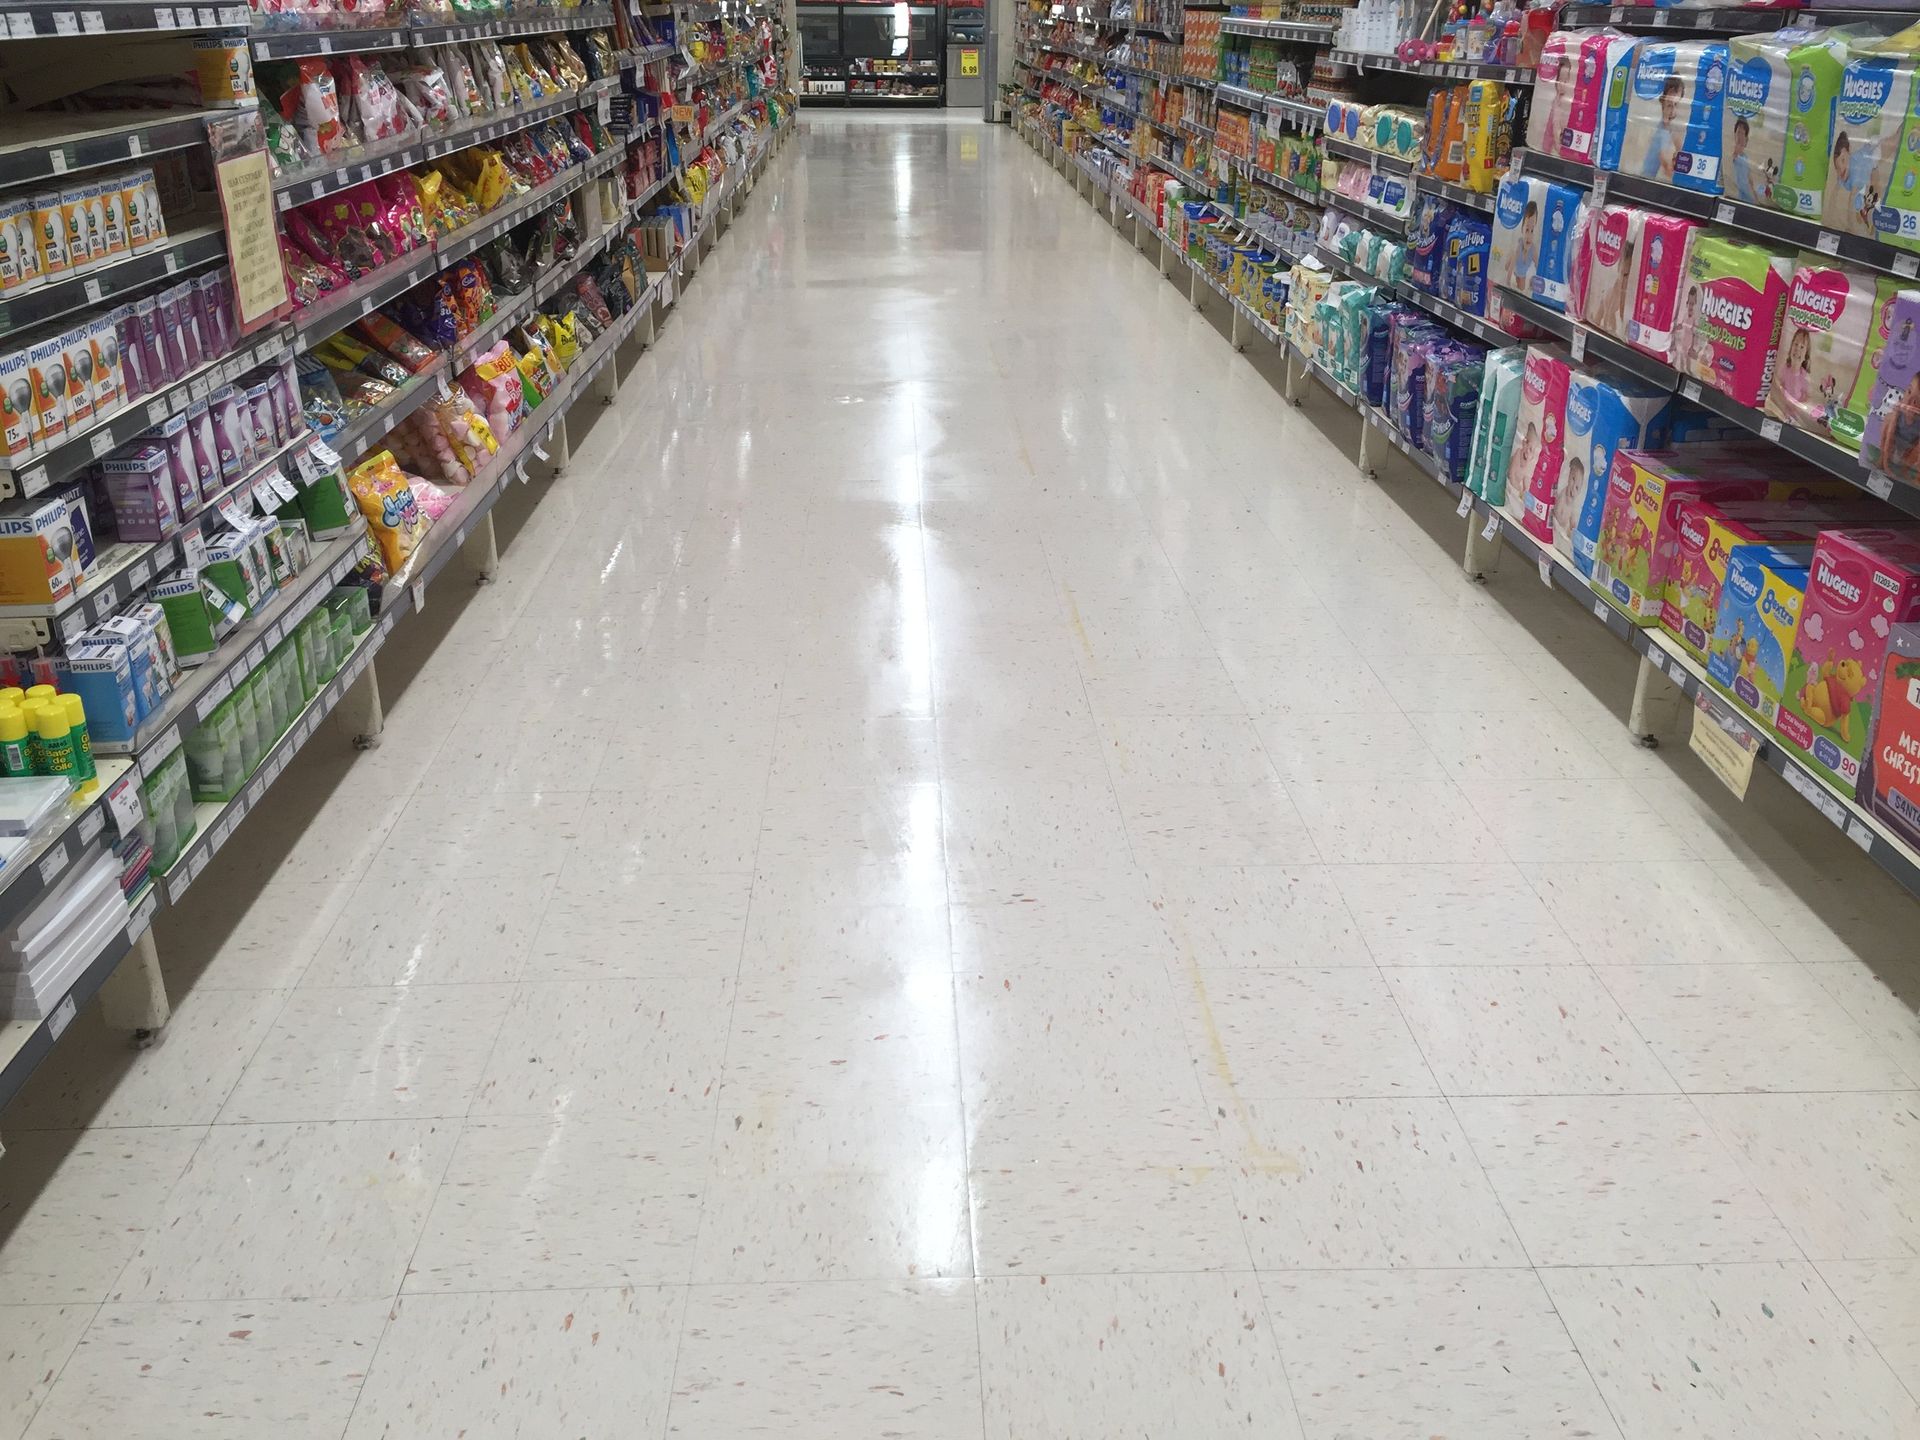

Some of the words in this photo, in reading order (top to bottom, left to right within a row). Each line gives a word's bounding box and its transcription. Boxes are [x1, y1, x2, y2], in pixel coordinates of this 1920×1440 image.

[962, 66, 977, 74] 6.99
[1729, 74, 1764, 99] HUGGIES
[1844, 75, 1884, 99] HUGGIES
[674, 108, 692, 117] NEW
[1696, 159, 1707, 172] 36
[63, 192, 84, 204] PHILIPS
[101, 182, 120, 195] PHILIPS
[37, 196, 60, 209] PHILIPS
[1500, 193, 1523, 214] HUGGIES
[1799, 193, 1813, 207] 28
[1902, 214, 1917, 230] 26
[1458, 231, 1485, 250] Pull-Ups
[1597, 226, 1622, 248] HUGGIES
[1470, 258, 1477, 272] L
[1471, 291, 1479, 304] 15
[1793, 280, 1837, 315] HUGGIES
[1701, 287, 1754, 331] HUGGIES
[89, 314, 114, 336] PHILIPS
[60, 327, 88, 349] PHILIPS
[30, 340, 61, 363] PHILIPS
[1524, 368, 1546, 394] HUGGIES
[1756, 349, 1778, 401] HUGGIES
[210, 386, 233, 403] PHILIPS
[246, 384, 267, 398] PHILIPS
[188, 398, 207, 416] PHILIPS
[1568, 396, 1592, 423] HUGGIES
[167, 413, 187, 433] PHILIPS
[105, 463, 146, 473] PHILIPS
[148, 451, 167, 469] PHILIPS
[1611, 473, 1632, 493] HUGGIES
[1634, 484, 1644, 505] 6
[1642, 493, 1659, 512] extra
[35, 502, 67, 532] PHILIPS
[262, 520, 280, 535] PHILIPS
[1680, 521, 1705, 548] HUGGIES
[1708, 537, 1721, 562] 8
[150, 582, 195, 599] PHILIPS
[1730, 567, 1758, 598] HUGGIES
[1817, 563, 1861, 604] HUGGIES
[1874, 573, 1899, 593] 11203-20
[1762, 588, 1775, 615] 8
[1771, 600, 1795, 627] extra
[82, 637, 124, 648] PHILIPS
[72, 662, 113, 672] PHILIPS
[50, 761, 73, 772] colle
[52, 756, 66, 765] de
[1840, 756, 1858, 777] 90
